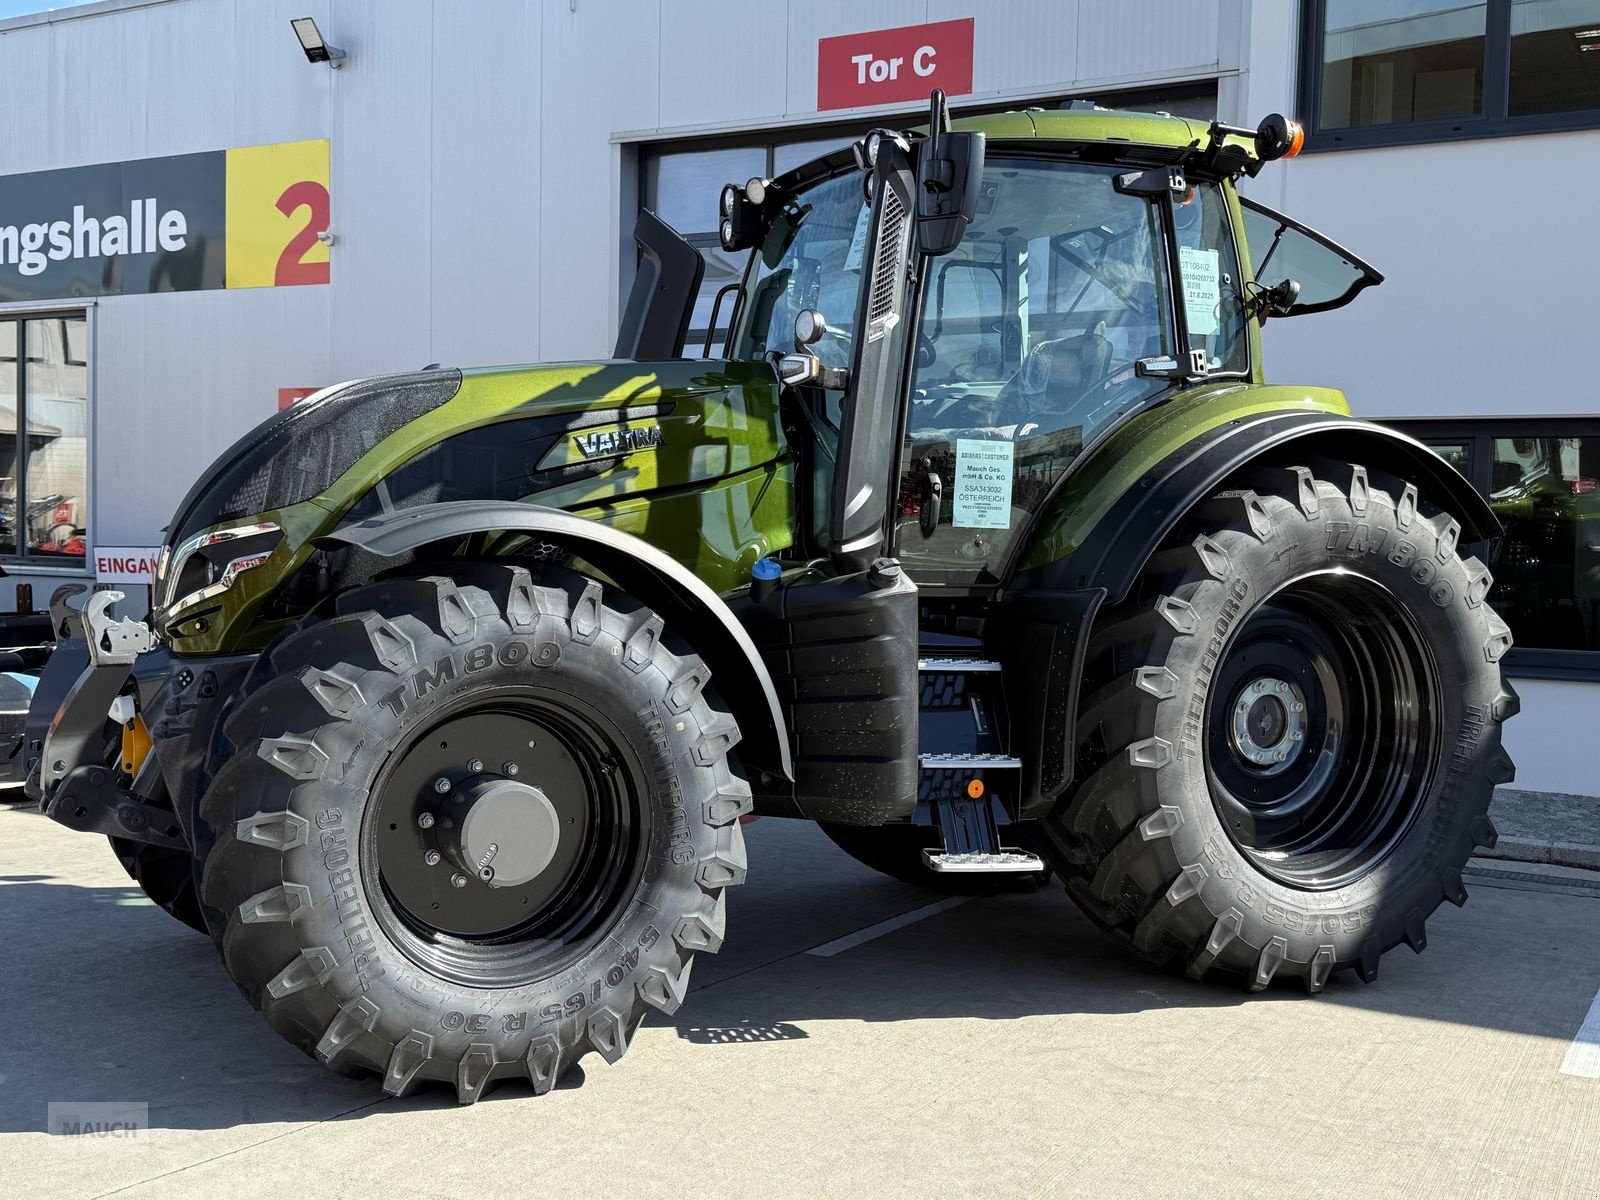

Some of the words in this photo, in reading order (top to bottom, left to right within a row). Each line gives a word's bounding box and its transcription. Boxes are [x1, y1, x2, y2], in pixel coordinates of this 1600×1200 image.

[851, 53, 903, 84] Tor
[912, 45, 936, 77] C
[0, 198, 188, 276] ngshalle
[274, 181, 331, 287] 2
[573, 425, 665, 459] VALTRA
[958, 493, 1005, 503] ÖSTERREICH
[1177, 576, 1249, 761] TRELLEBORG
[635, 698, 696, 866] TRELLEBORG
[313, 806, 387, 993] TRELLEBORG
[440, 1010, 492, 1035] 30
[502, 1011, 528, 1035] R
